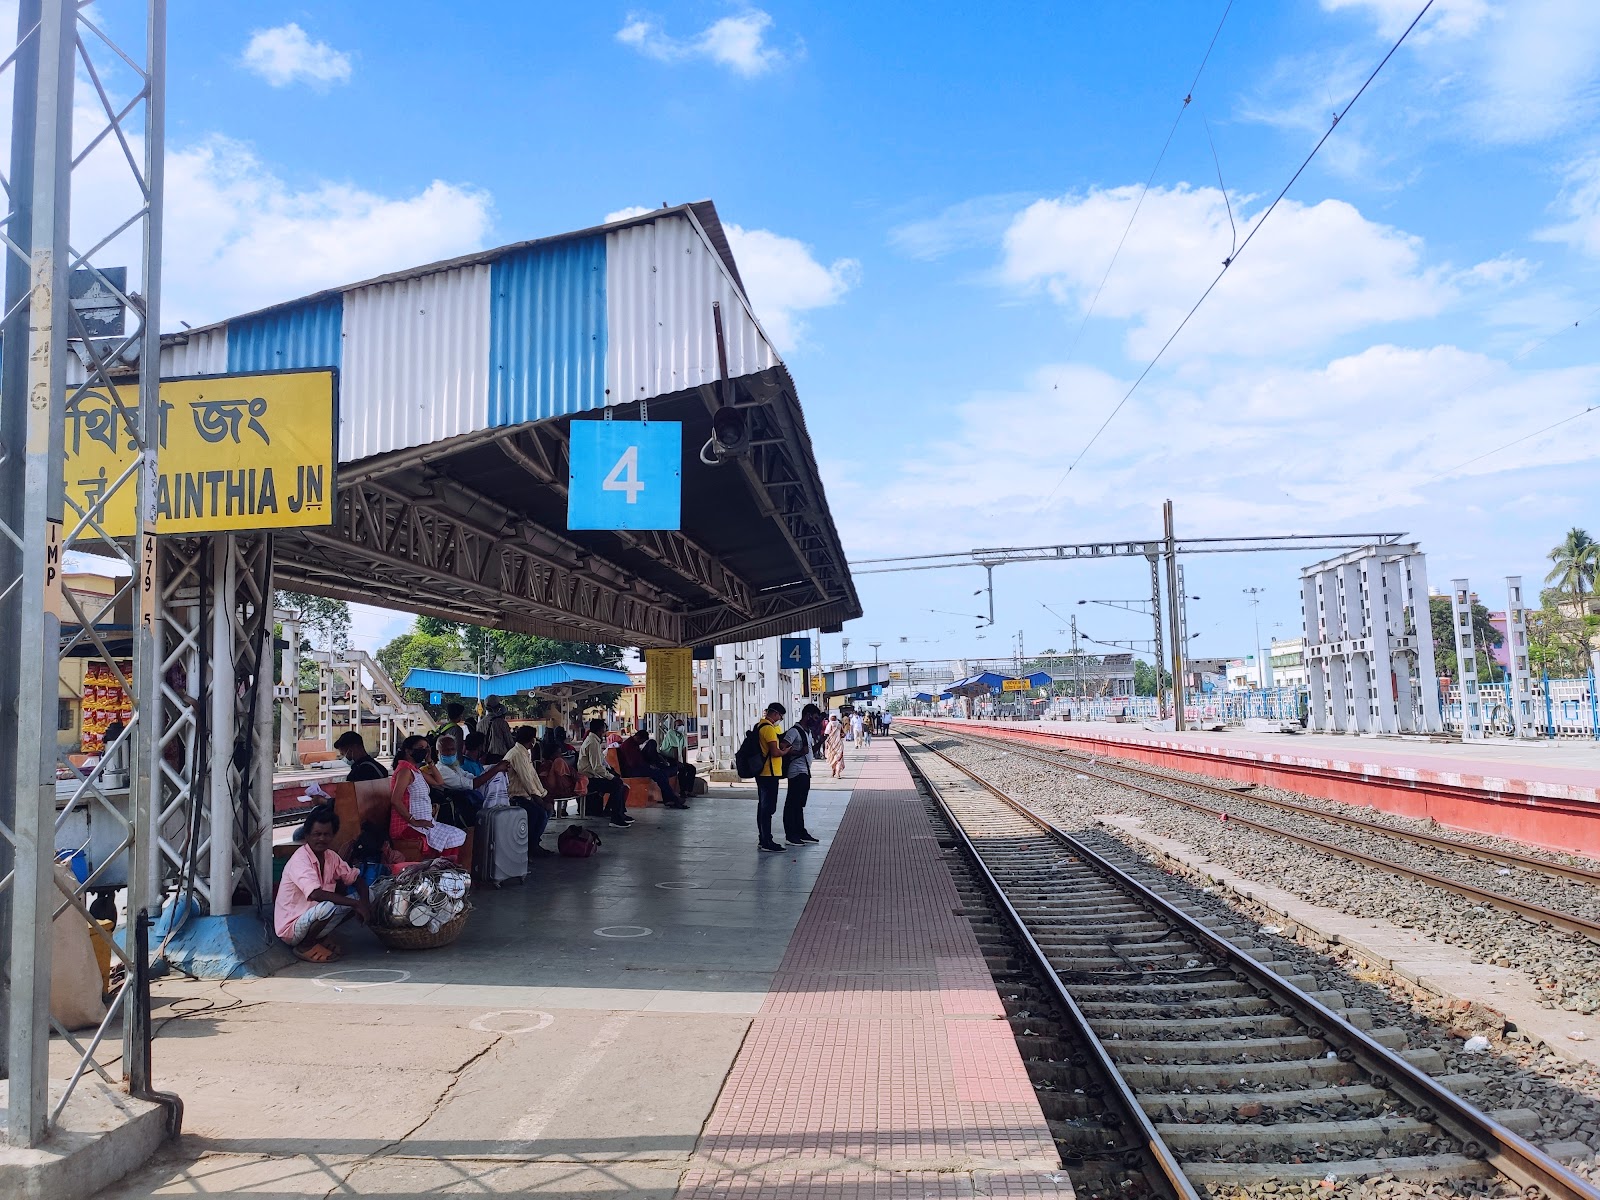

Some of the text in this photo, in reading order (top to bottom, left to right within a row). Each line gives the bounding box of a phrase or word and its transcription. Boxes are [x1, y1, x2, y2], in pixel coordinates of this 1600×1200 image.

[189, 398, 270, 446] জং
[136, 467, 279, 522] AINTHIA
[287, 465, 323, 514] JN
[602, 446, 645, 504] 4
[46, 525, 58, 587] IMP
[789, 644, 802, 662] 4
